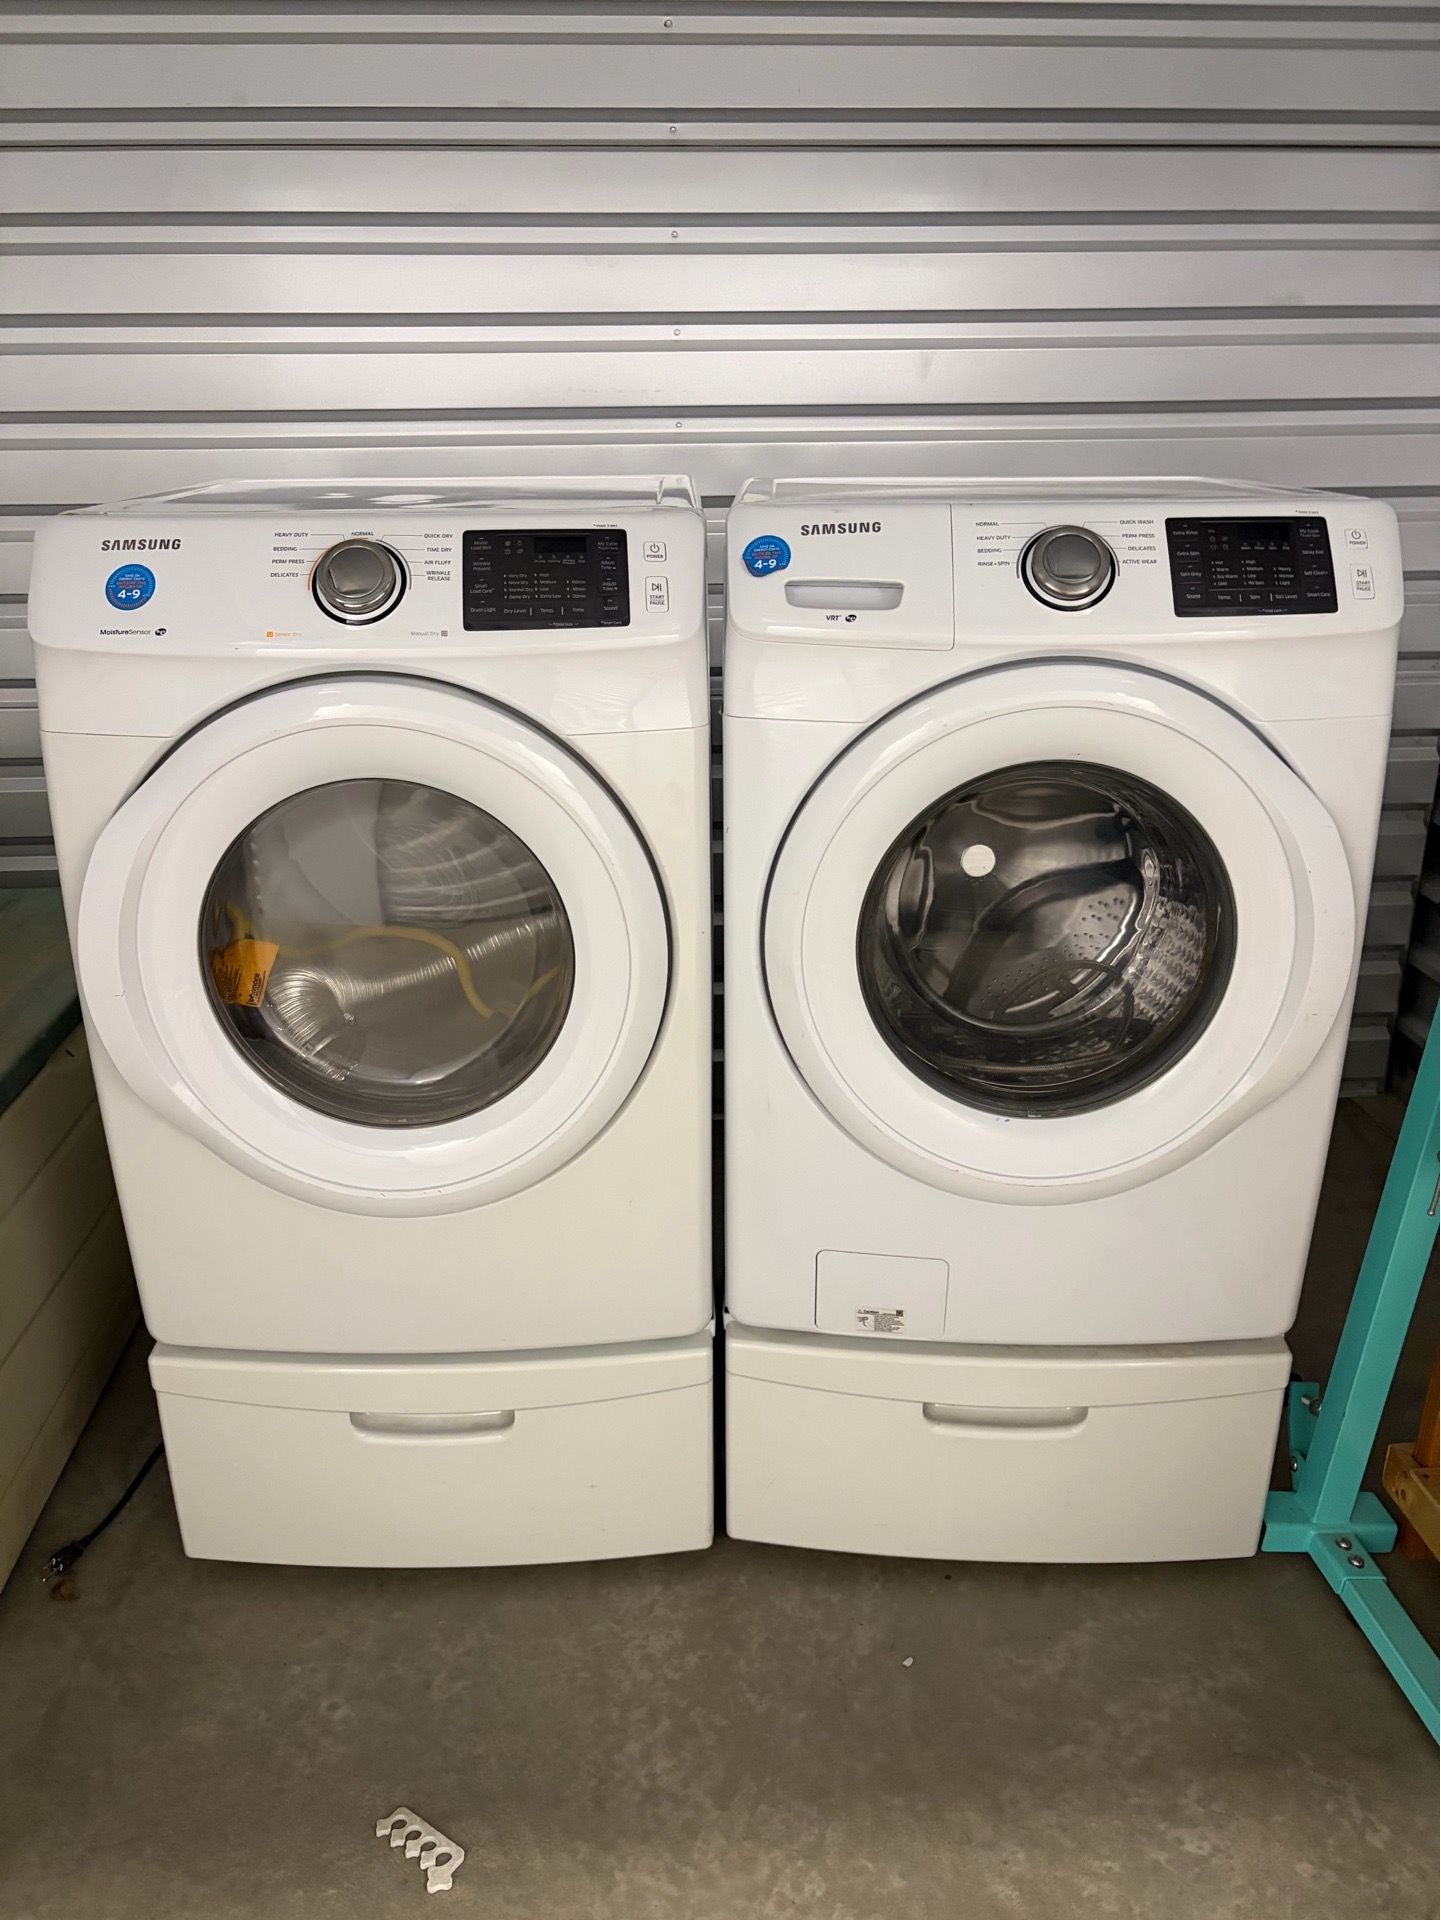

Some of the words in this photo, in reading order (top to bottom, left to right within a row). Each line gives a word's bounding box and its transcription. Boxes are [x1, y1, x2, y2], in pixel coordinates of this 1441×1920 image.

[800, 522, 881, 536] SAMSUNG
[101, 538, 182, 551] SAMSUNG
[754, 559, 777, 569] 4-9
[118, 589, 141, 599] 4-9
